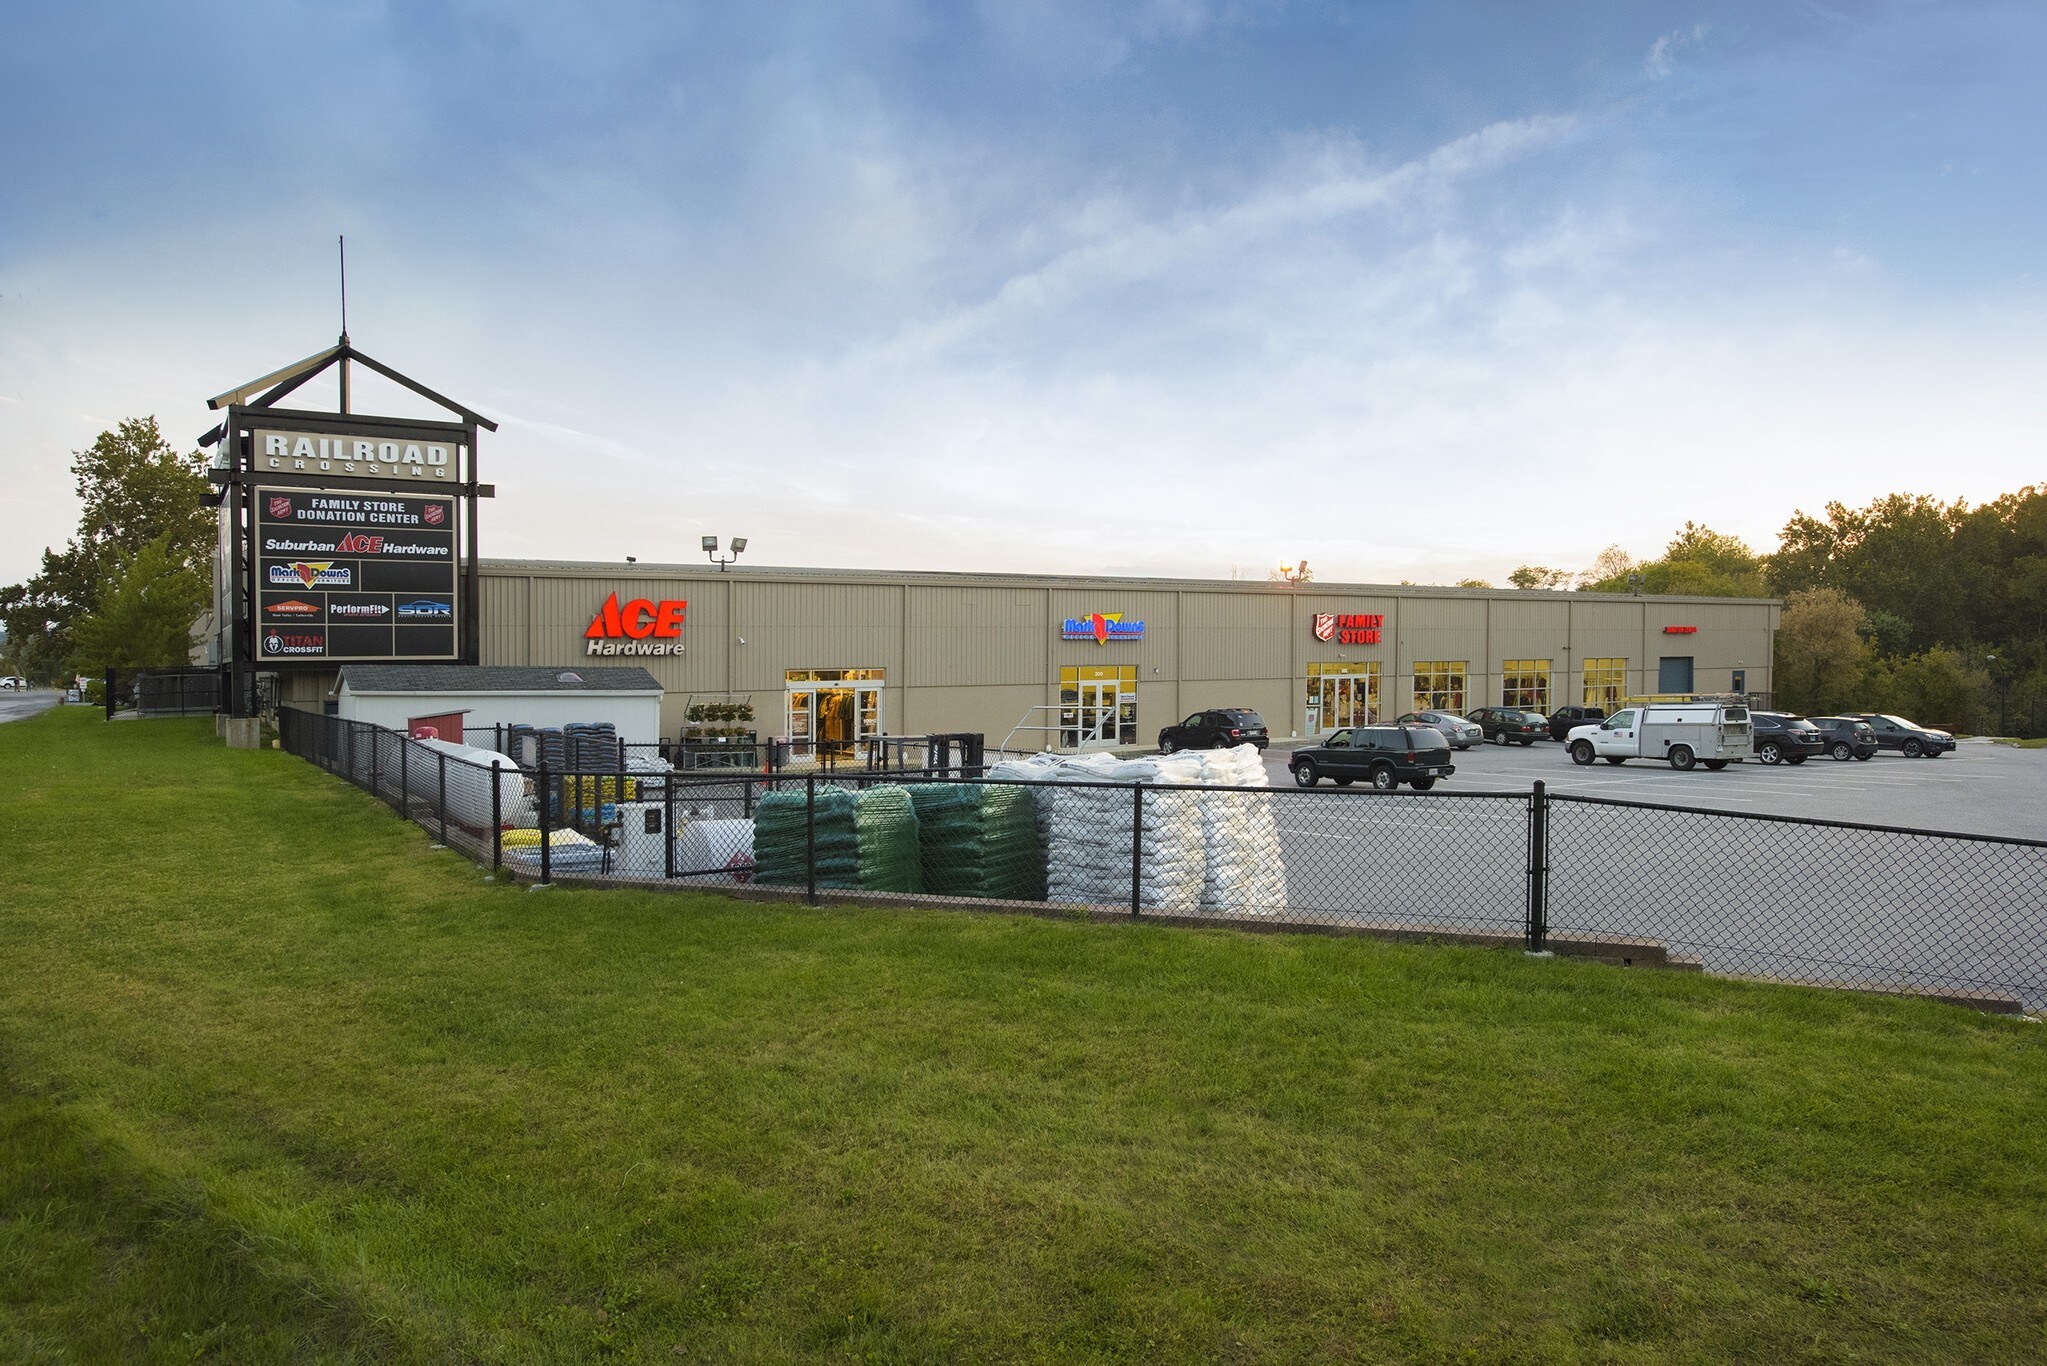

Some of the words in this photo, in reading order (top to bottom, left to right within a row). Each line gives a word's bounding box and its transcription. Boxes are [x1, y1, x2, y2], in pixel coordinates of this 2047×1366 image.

[265, 435, 448, 466] RAILROAD
[269, 457, 445, 478] CROSSING
[311, 498, 360, 511] FAMILY
[363, 501, 406, 513] STORE
[297, 509, 365, 522] DONATION
[369, 512, 420, 524] CENTER
[265, 538, 336, 552] Suburban
[335, 531, 384, 554] ACE
[382, 542, 449, 555] Hardware
[271, 566, 301, 577] Mark
[330, 604, 383, 614] PerformFit
[584, 591, 688, 639] ACE
[1064, 618, 1095, 632] Mark
[1337, 614, 1385, 628] FAMILY
[283, 635, 324, 646] TITAN
[1339, 629, 1382, 644] STORE
[586, 640, 686, 657] Hardware
